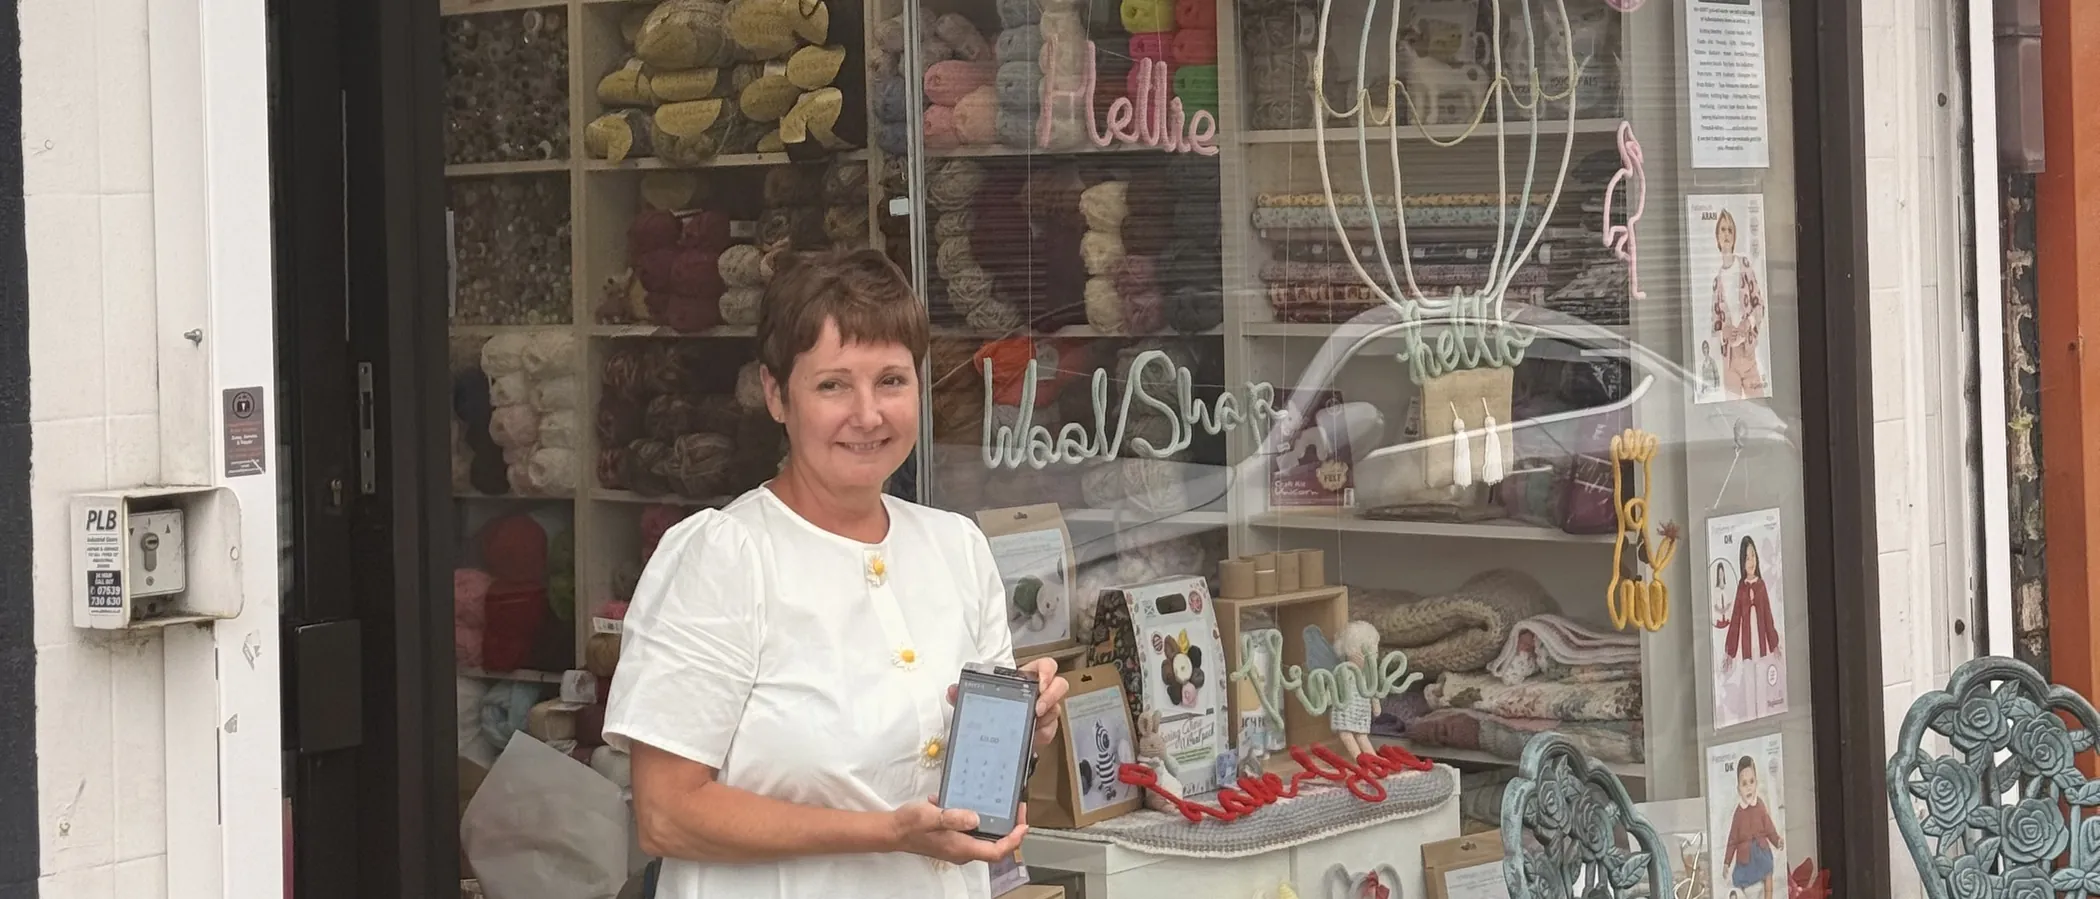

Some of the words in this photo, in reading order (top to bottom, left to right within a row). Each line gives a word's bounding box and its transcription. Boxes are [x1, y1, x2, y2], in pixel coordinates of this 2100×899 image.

[1396, 286, 1538, 385] hello
[86, 509, 117, 531] PLB
[1724, 534, 1733, 544] DK
[91, 596, 105, 606] 730
[1724, 762, 1734, 773] DK
